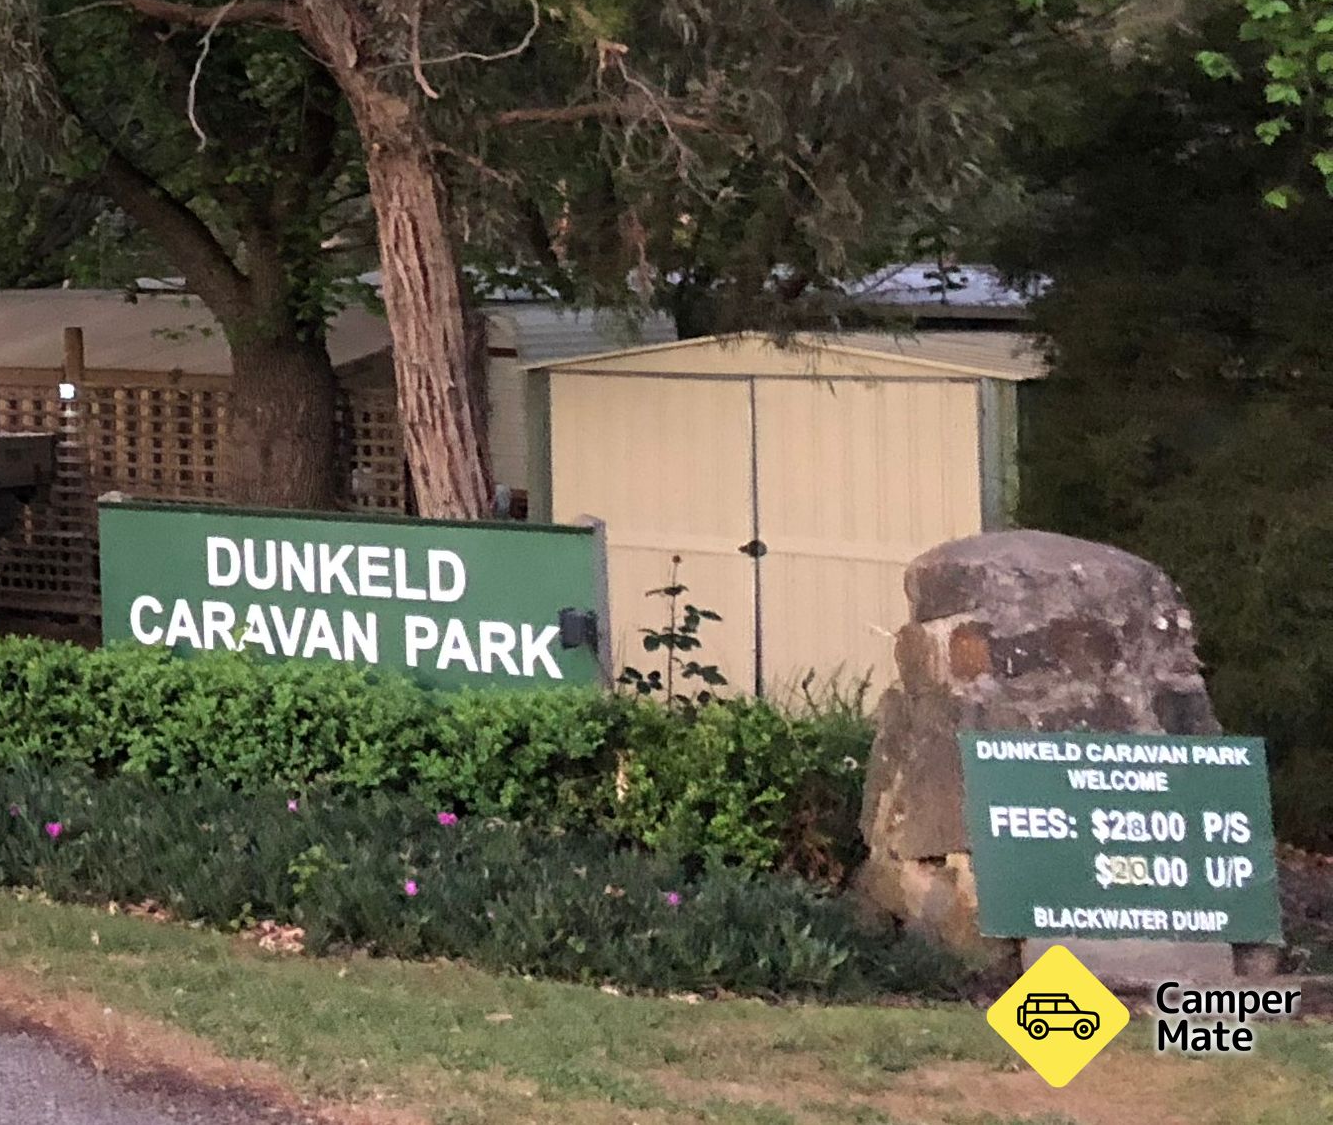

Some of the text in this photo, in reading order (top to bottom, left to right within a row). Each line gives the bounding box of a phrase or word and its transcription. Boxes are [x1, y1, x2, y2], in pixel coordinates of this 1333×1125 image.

[206, 536, 466, 603] DUNKELD
[130, 595, 564, 679] CARAVAN PARK
[976, 740, 1251, 766] DUNKELD CARAVAN PARK
[1067, 769, 1170, 792] WELCOME
[988, 805, 1079, 839] FEES:
[1202, 810, 1251, 844] P/S
[1204, 855, 1254, 889] U/P
[1033, 905, 1229, 932] BLACKWATER DUMP
